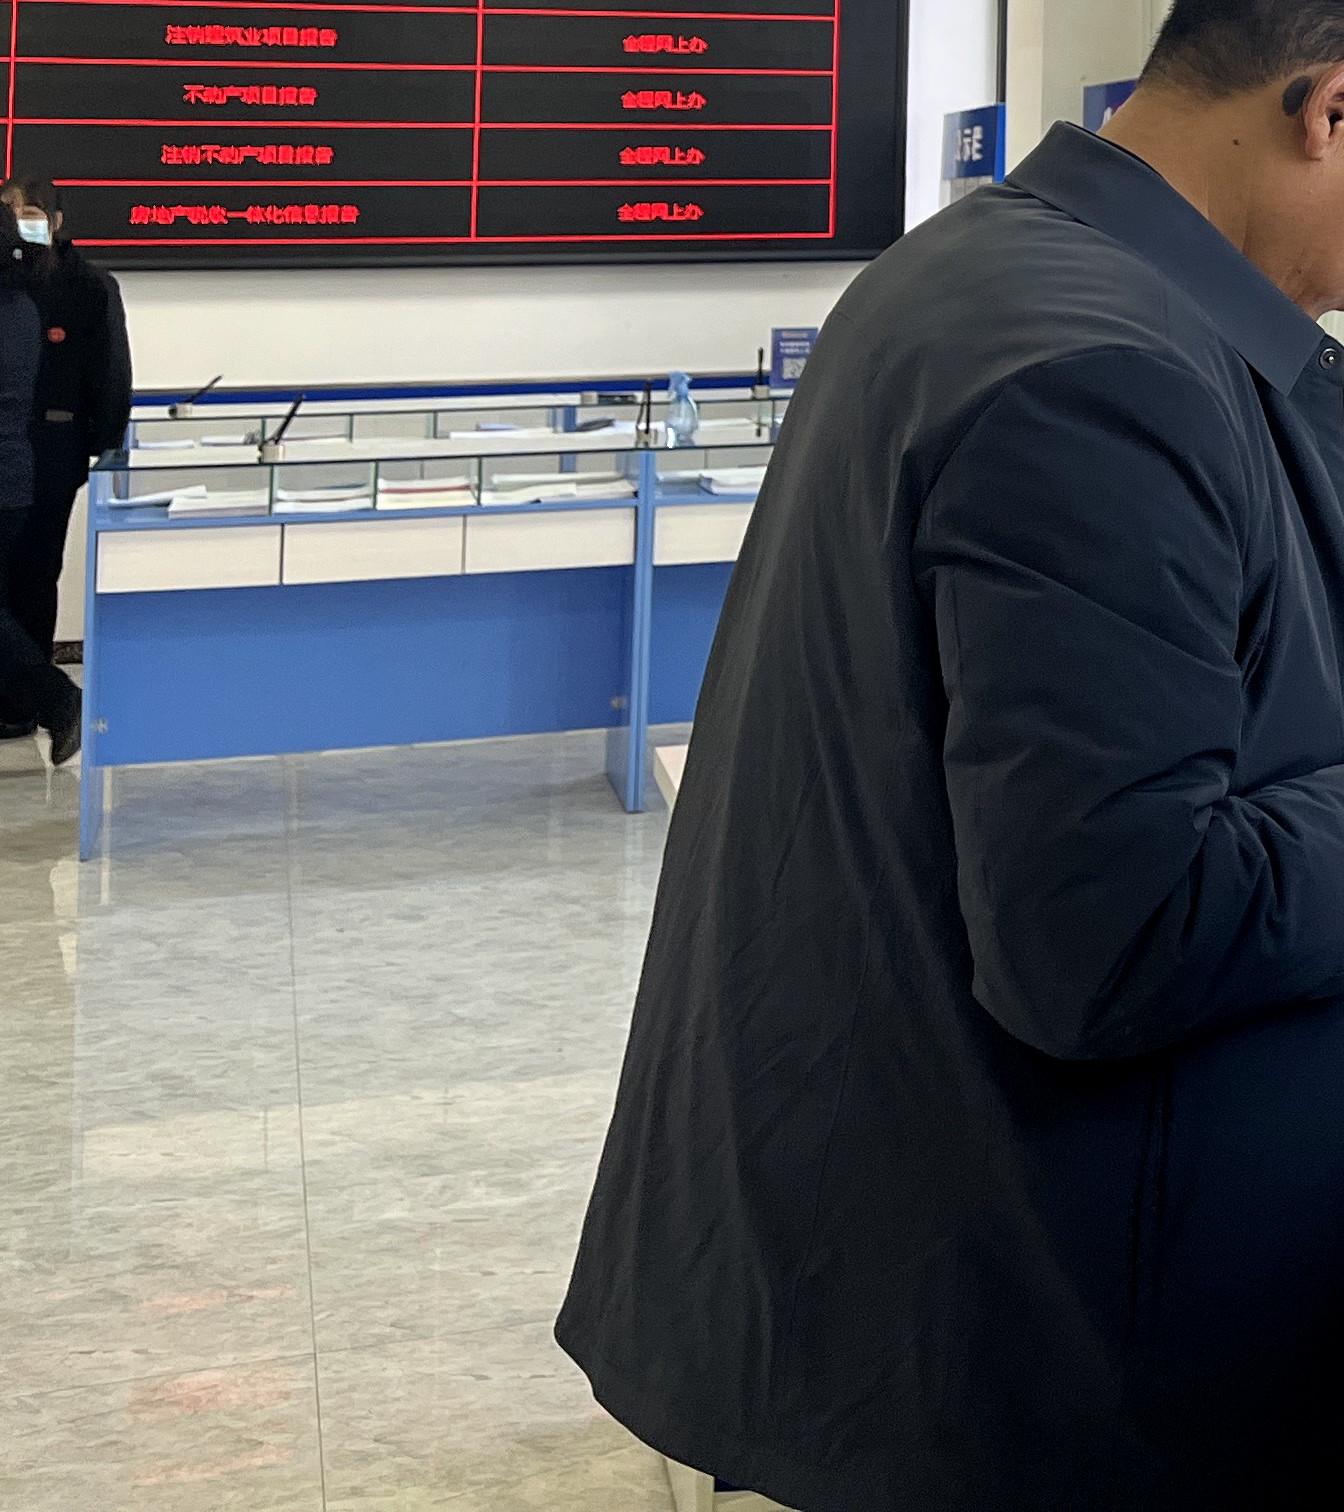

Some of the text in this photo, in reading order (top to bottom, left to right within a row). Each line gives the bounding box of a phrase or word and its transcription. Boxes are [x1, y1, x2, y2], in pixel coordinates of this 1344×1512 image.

[165, 24, 338, 47] 注销建筑业项目报告
[183, 84, 318, 106] 不动产项目报告
[161, 144, 334, 165] 注销不动产项目报告
